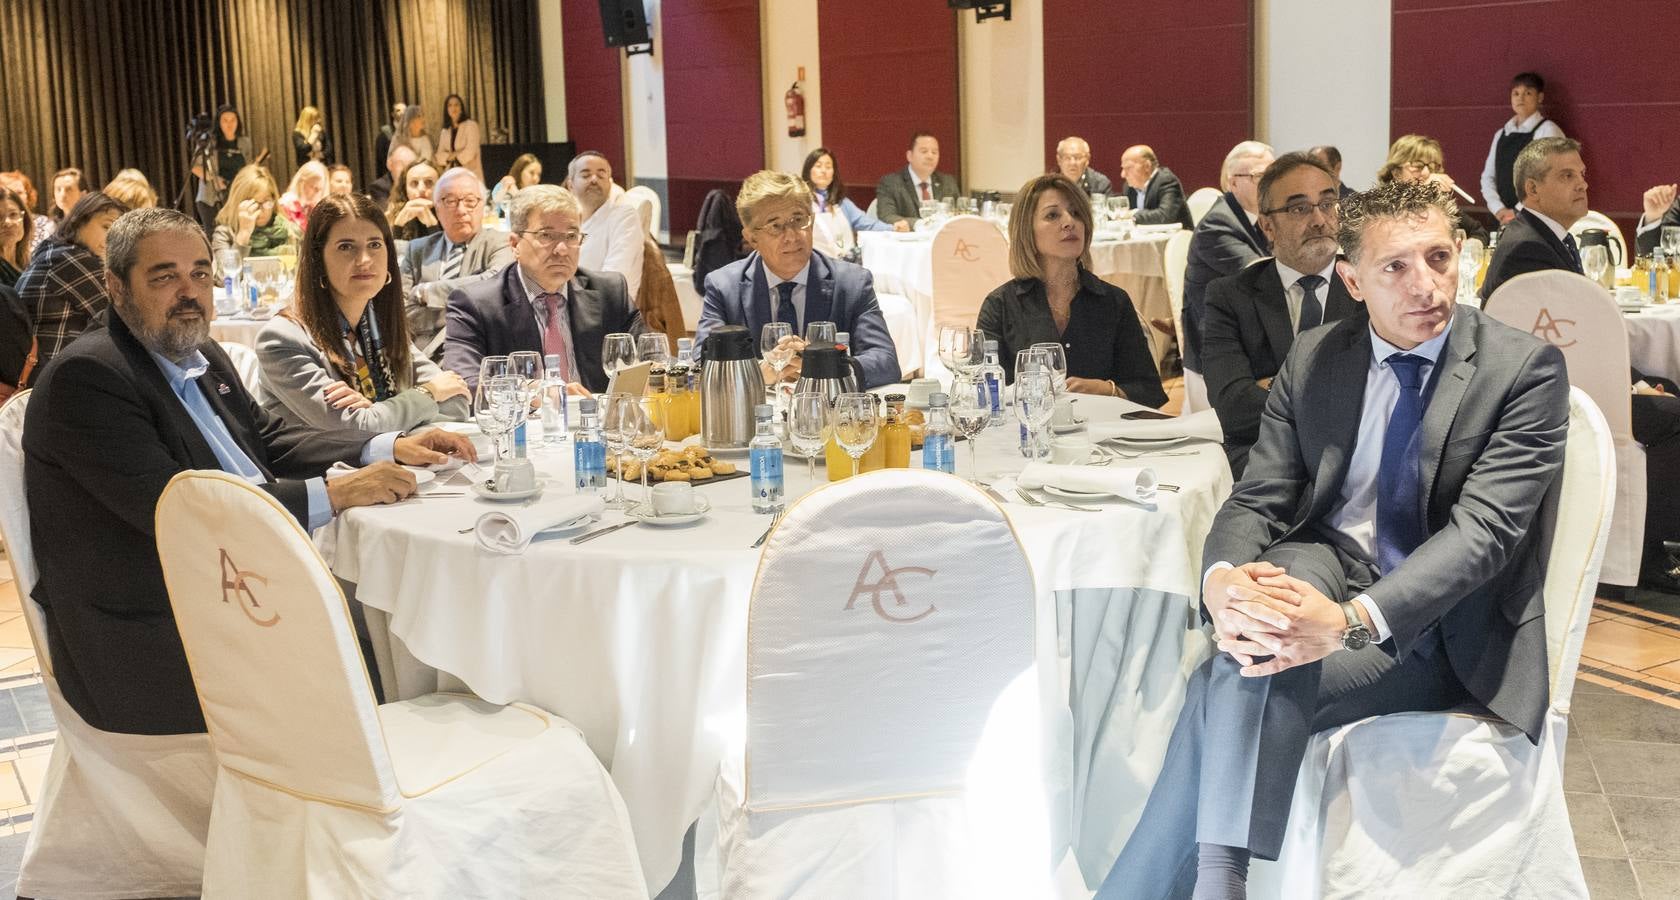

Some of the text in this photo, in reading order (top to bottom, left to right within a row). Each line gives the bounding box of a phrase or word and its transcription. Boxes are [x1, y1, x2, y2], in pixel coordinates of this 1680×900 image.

[953, 238, 981, 262] AC
[1531, 308, 1577, 348] AC
[218, 547, 282, 627] AC
[843, 549, 938, 624] AC
